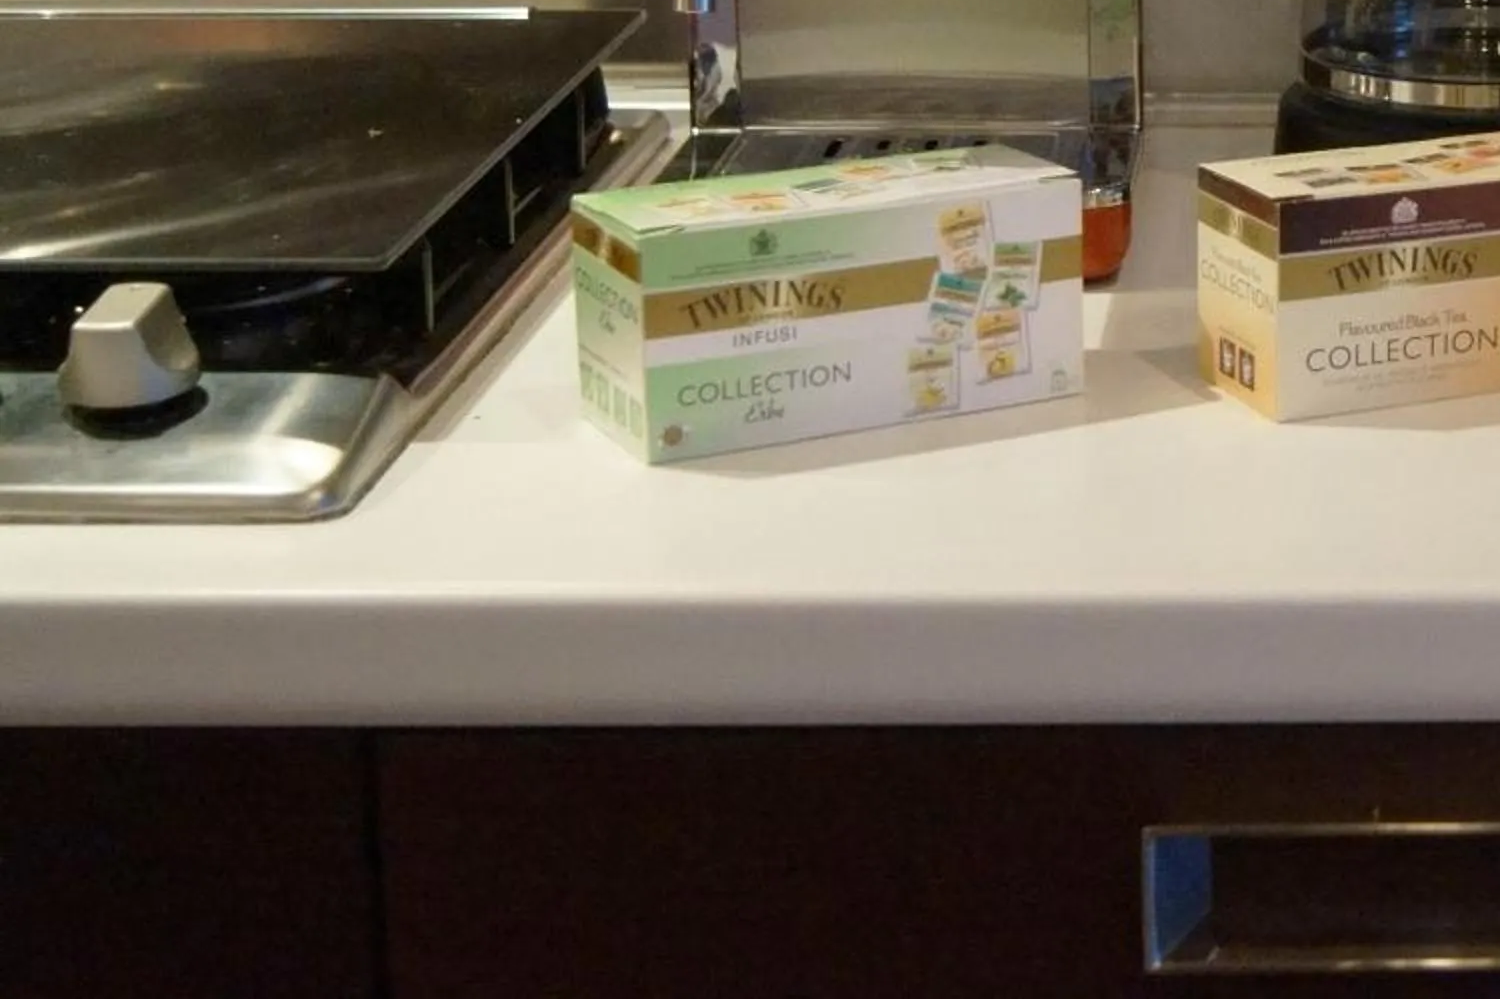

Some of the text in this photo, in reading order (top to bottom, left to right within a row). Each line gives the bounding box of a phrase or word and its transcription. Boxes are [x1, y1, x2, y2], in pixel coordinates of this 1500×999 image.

[1328, 246, 1479, 291] TWININGS
[679, 279, 846, 330] TWININGS
[732, 326, 798, 348] INFUSI
[1305, 325, 1500, 373] COLLECTION
[677, 361, 852, 407] COLLECTION
